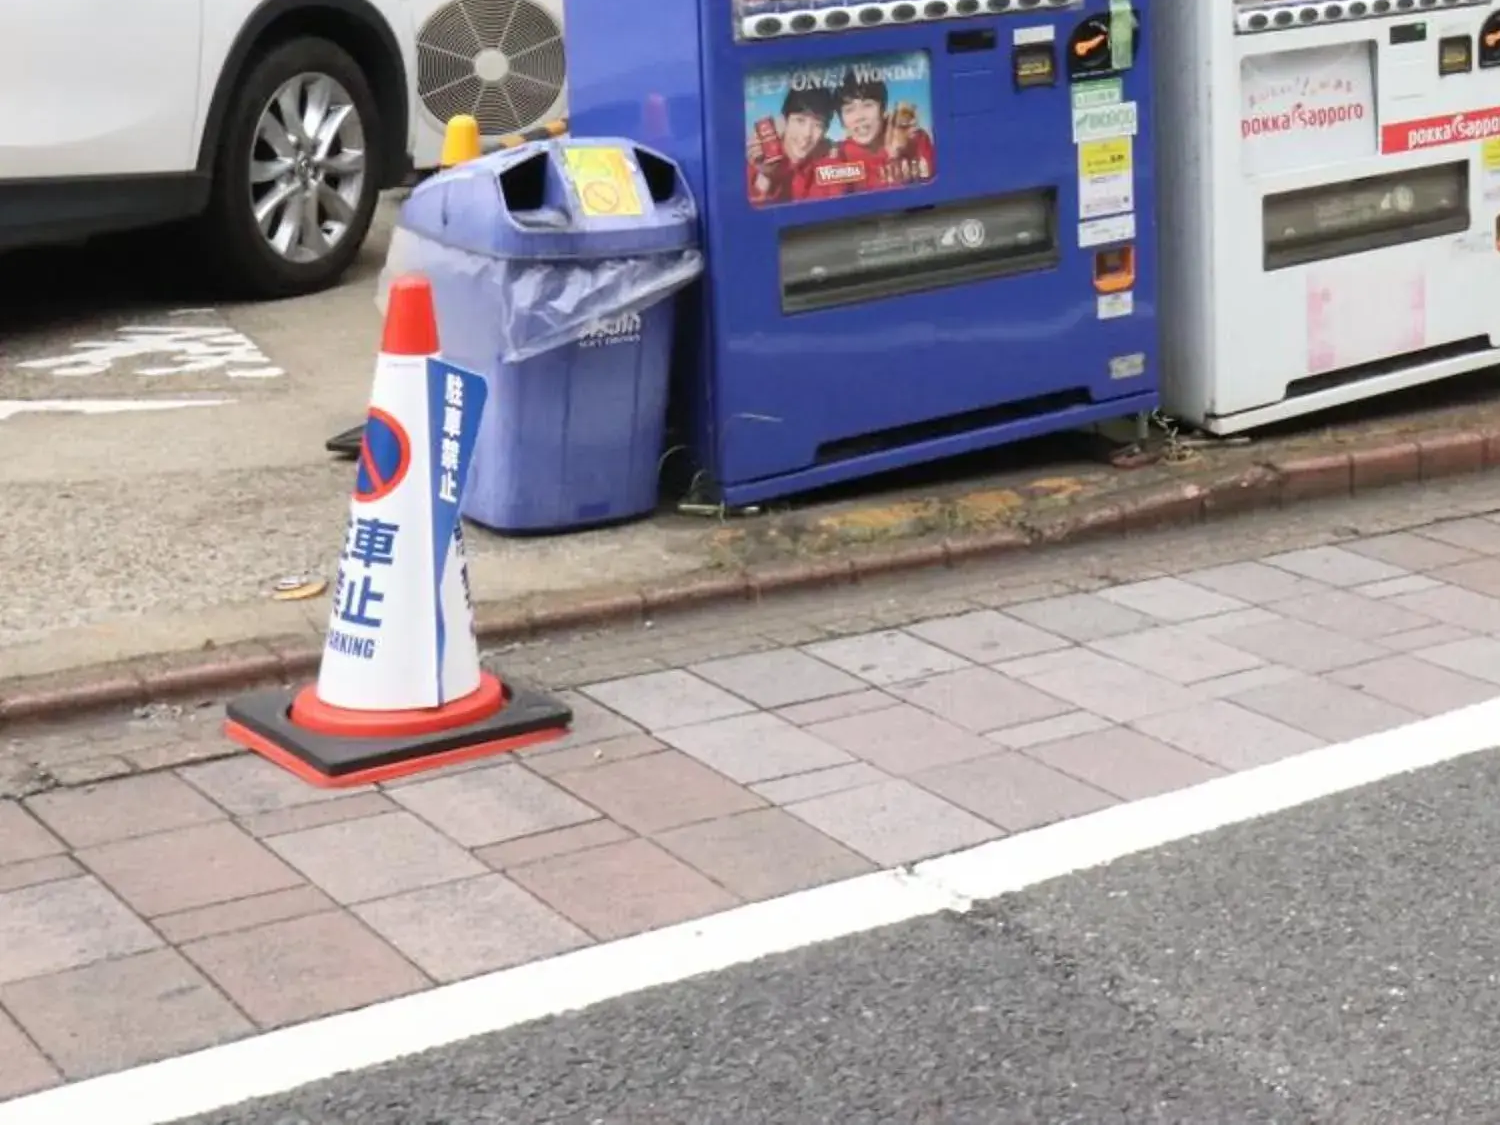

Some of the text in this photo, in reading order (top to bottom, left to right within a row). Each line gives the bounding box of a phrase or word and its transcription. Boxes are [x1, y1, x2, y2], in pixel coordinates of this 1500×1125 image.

[440, 373, 464, 503] 駐車禁止
[345, 517, 400, 568] 車
[332, 569, 385, 628] 止
[328, 629, 375, 660] ARKING
